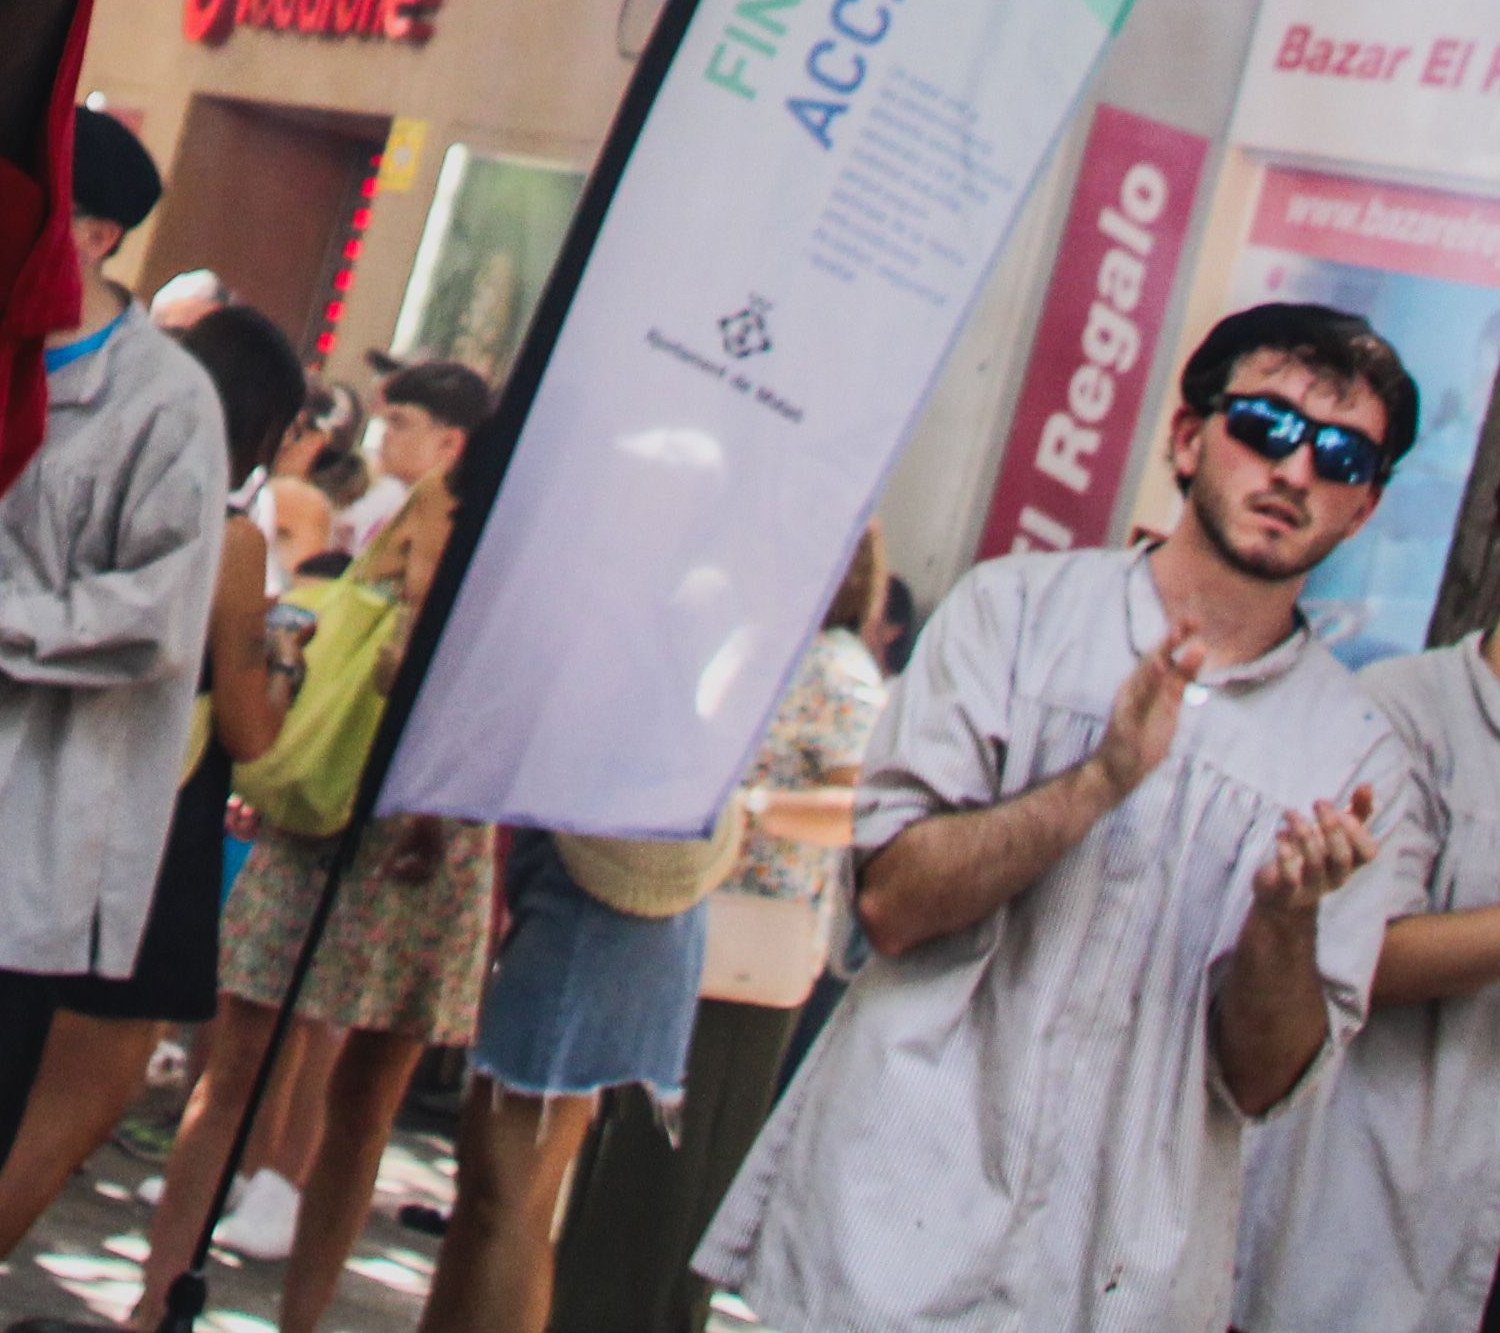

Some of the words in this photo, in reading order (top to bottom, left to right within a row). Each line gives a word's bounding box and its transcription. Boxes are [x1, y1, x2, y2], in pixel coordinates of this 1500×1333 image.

[1273, 24, 1412, 81] Bazar
[1418, 37, 1477, 89] El
[1034, 162, 1169, 494] Regalo
